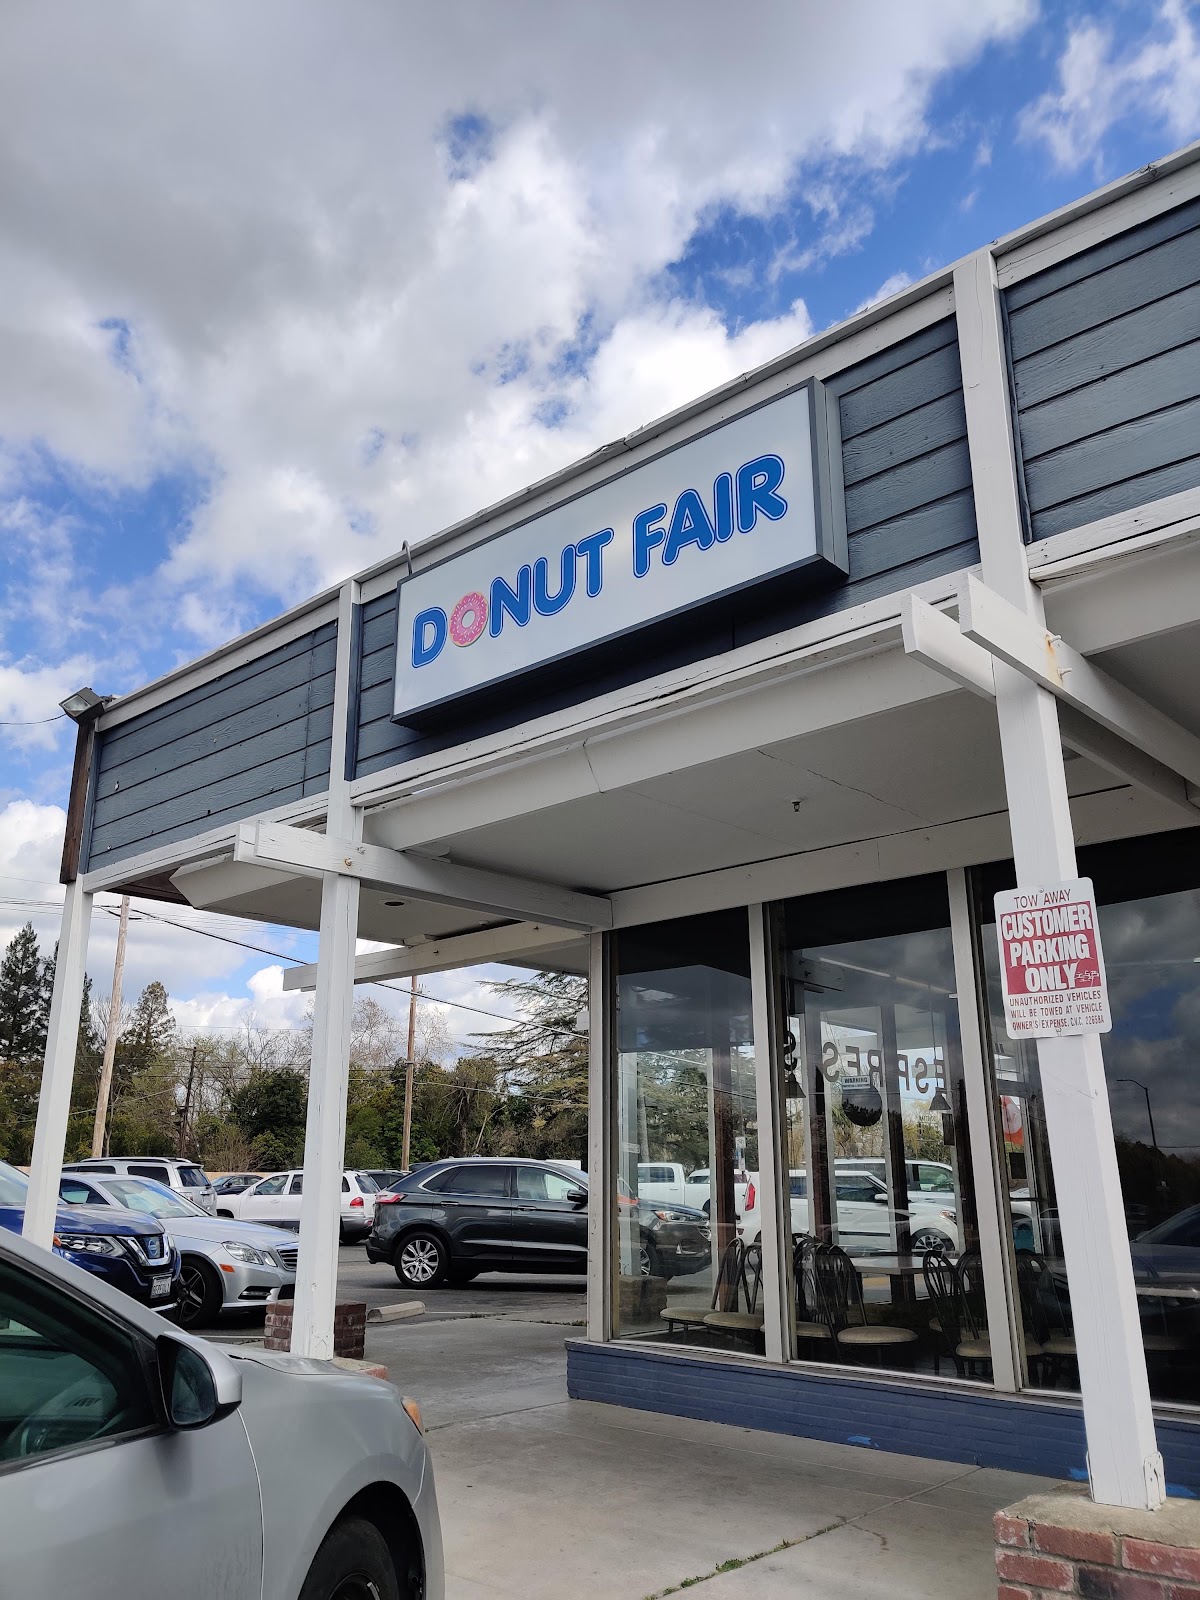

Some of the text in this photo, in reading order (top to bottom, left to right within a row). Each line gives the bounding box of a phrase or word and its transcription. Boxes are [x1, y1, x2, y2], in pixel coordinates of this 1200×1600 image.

[411, 453, 788, 668] DONUT FAIR
[1014, 889, 1071, 909] TOW AWAY
[1001, 903, 1093, 941] CUSTOMER
[1009, 934, 1090, 967] PARKING
[1025, 962, 1079, 992] ONLY
[1010, 990, 1101, 1007] UNAUTHORIZED VEHICLES
[1010, 1002, 1102, 1018] WILL BE TOWED AT VEHICLE
[1012, 1020, 1039, 1031] OWNER'S
